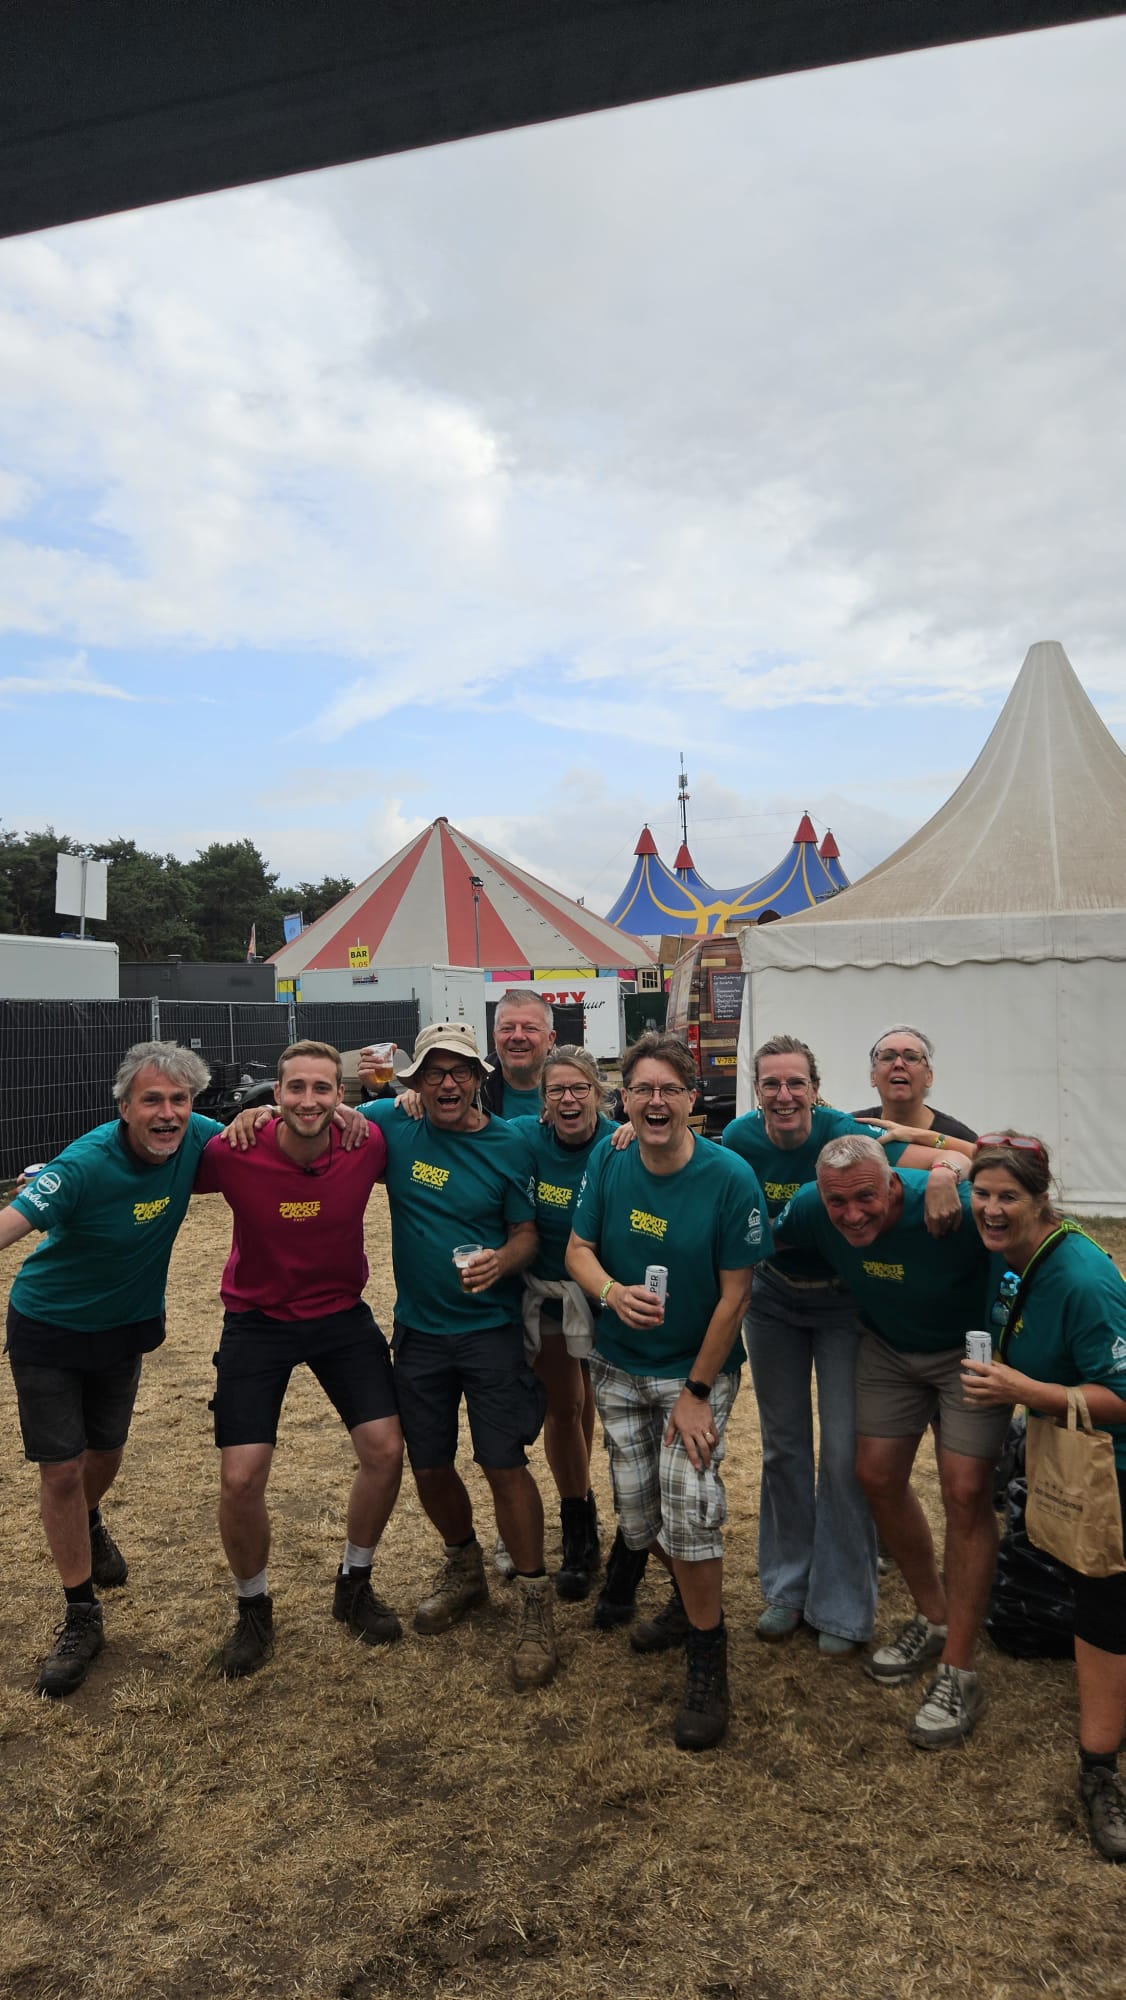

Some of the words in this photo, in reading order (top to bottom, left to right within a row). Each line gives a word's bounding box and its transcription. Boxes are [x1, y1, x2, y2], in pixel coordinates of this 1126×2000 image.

[350, 950, 367, 959] BAR
[411, 1160, 450, 1182] ZWARTE
[412, 1170, 444, 1187] CROSS
[537, 1181, 573, 1200] ZWARTE
[279, 1201, 320, 1213] ZWARTE
[282, 1209, 318, 1218] CROSS
[629, 1209, 668, 1232] ZWARTE
[632, 1219, 664, 1238] CROSS
